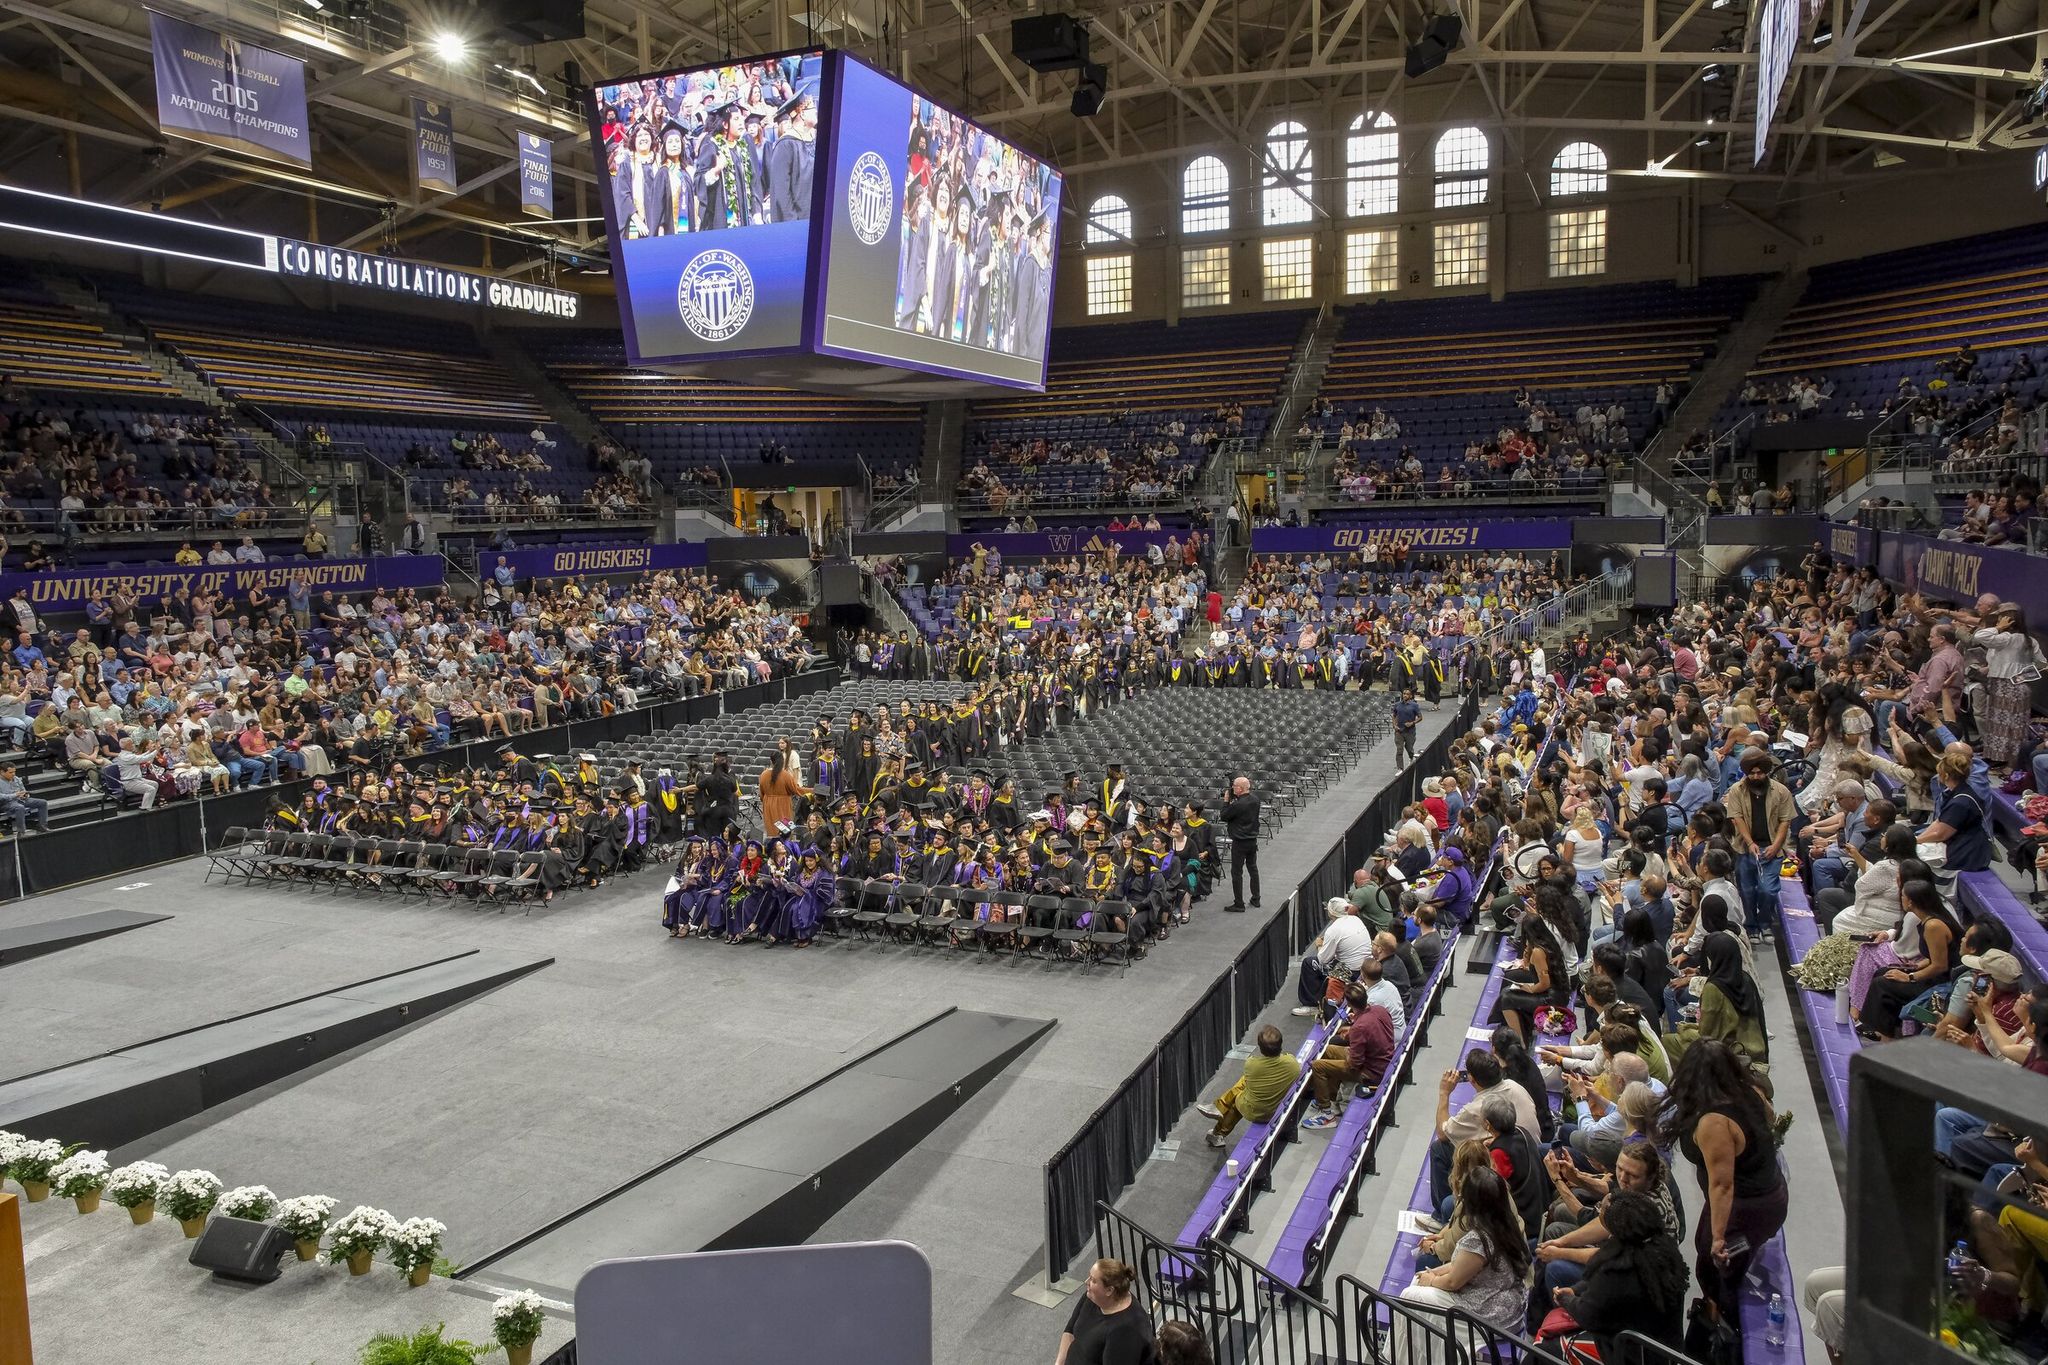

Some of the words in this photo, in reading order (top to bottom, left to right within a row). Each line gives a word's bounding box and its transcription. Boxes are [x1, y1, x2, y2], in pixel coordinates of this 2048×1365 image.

[183, 48, 224, 69] WOMEN'S
[211, 78, 259, 112] 2005
[171, 94, 231, 120] NATIONAL
[234, 112, 299, 138] CHAMPIONS
[419, 127, 450, 145] FINAL
[421, 139, 450, 156] FOUR
[427, 157, 446, 171] 1953
[523, 158, 549, 175] FINAL
[525, 169, 548, 185] FOUR
[529, 185, 545, 198] 2016
[282, 243, 481, 302] CONGRATULATIONS
[489, 282, 577, 318] GRADUATES
[680, 260, 702, 334] UNIVERSITY
[702, 252, 718, 263] OF
[722, 253, 752, 331] WASHINGTON
[708, 328, 729, 339] 1861
[1048, 534, 1071, 552] W
[1333, 529, 1363, 547] GO
[554, 552, 576, 571] GO
[577, 548, 651, 570] HUSKIES!
[1925, 547, 1952, 589] DAWG
[1951, 552, 1983, 598] PACK
[31, 573, 195, 602] UNIVERSITY
[200, 571, 230, 592] OF
[235, 563, 368, 590] WASHNGTON
